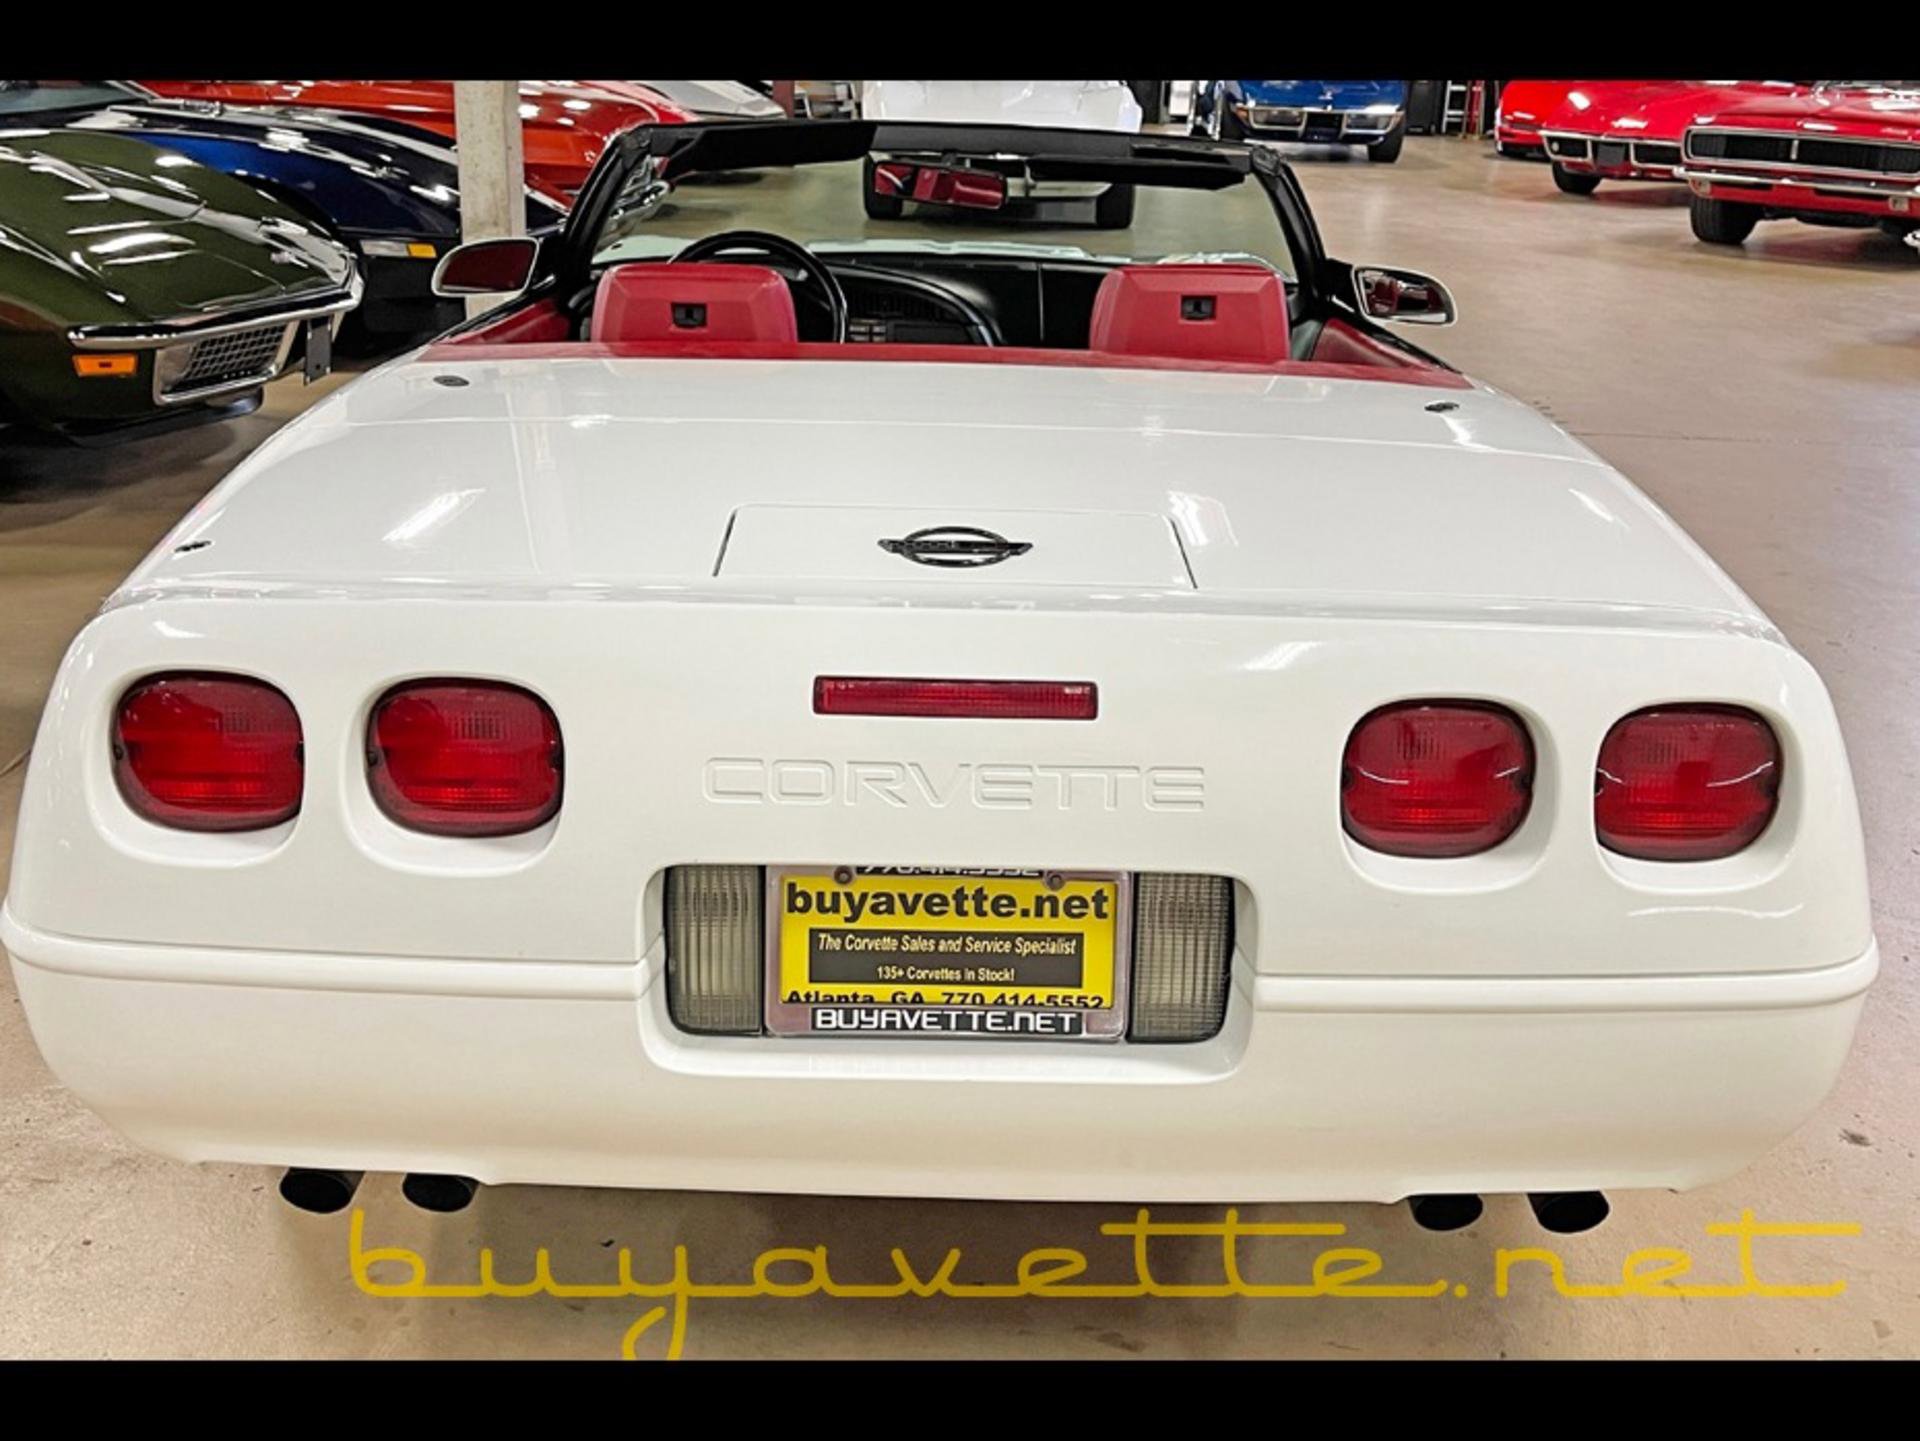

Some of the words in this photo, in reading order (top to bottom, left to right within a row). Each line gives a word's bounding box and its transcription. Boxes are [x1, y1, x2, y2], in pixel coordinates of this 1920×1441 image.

[703, 756, 1206, 813] CORVETTE
[786, 881, 1109, 924] buyavette.net
[818, 932, 842, 951] The
[845, 933, 899, 951] Corvette
[901, 934, 936, 953] Sales
[937, 936, 963, 953] and
[965, 936, 1012, 954] Service
[1014, 936, 1077, 957] Specialist
[877, 965, 905, 980] 135+
[906, 966, 961, 981] Corvettes
[964, 968, 976, 981] in
[978, 967, 1015, 981] Stock!
[815, 1008, 1077, 1033] BUYAVETTE.NET
